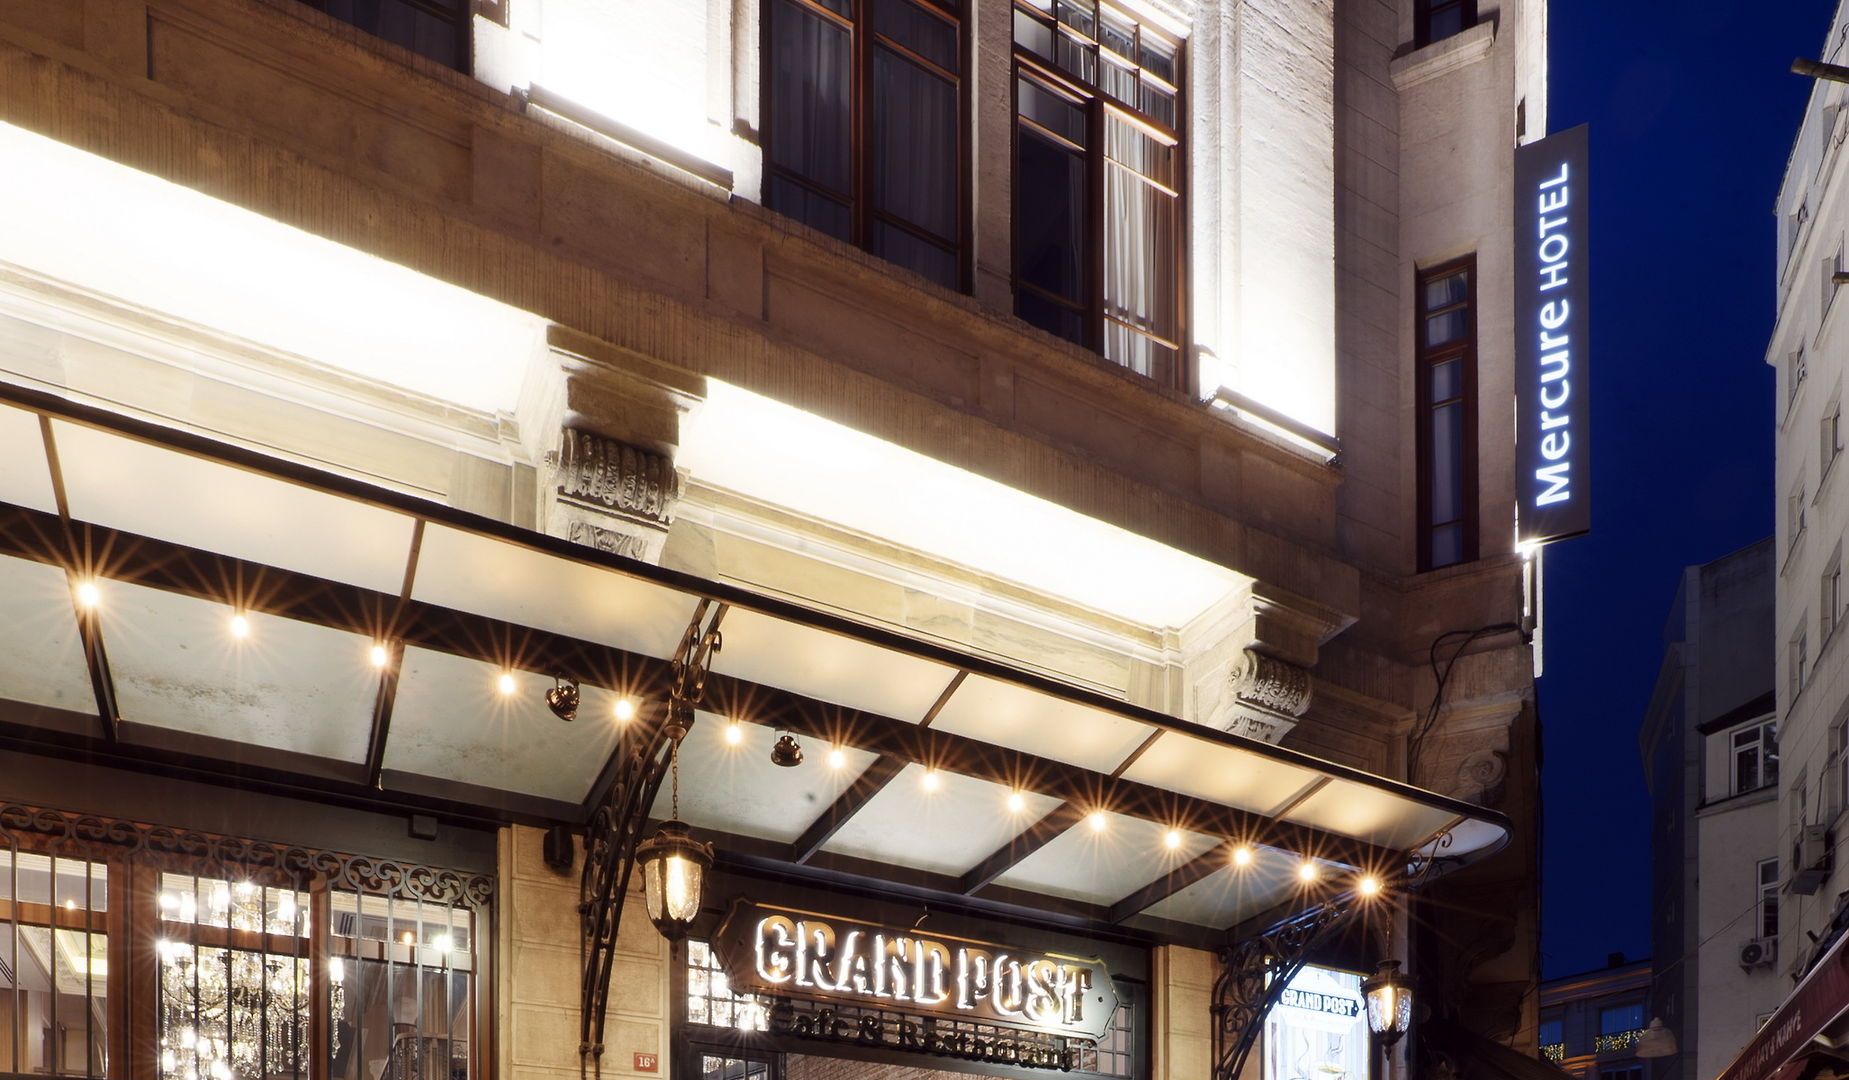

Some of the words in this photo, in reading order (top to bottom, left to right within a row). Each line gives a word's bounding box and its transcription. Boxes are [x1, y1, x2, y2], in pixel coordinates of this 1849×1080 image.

[1539, 162, 1569, 292] HOTEL
[1536, 299, 1570, 507] Mercure
[755, 914, 952, 1007] GRAND
[955, 947, 1094, 1026] POST
[1281, 988, 1322, 1011] GRAND
[1323, 995, 1355, 1016] POST
